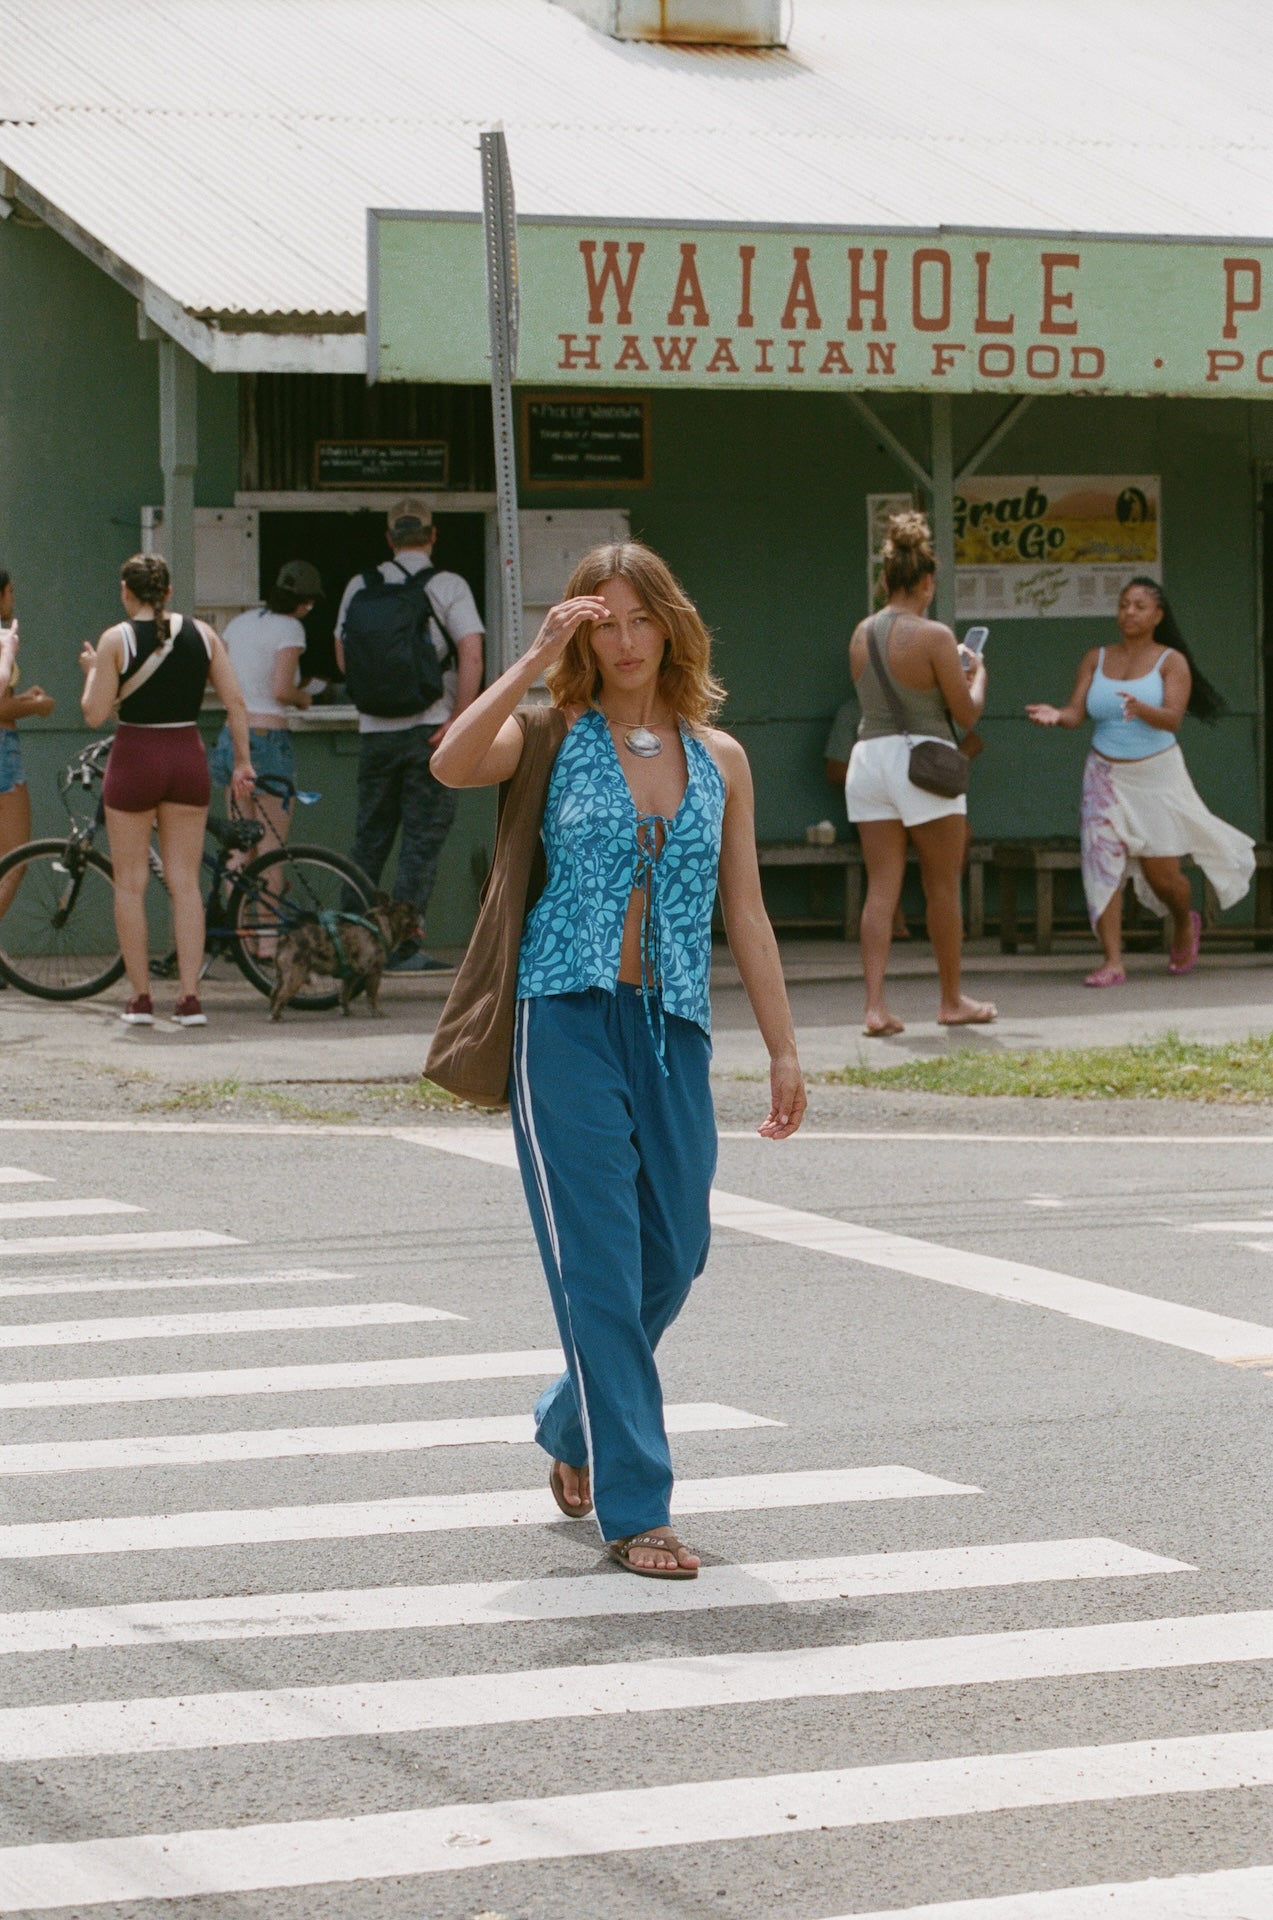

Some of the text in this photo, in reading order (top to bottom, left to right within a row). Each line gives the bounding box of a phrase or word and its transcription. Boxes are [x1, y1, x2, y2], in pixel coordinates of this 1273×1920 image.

[579, 240, 1080, 335] WAIAHOLE
[558, 334, 896, 374] HAWAIIAN
[931, 343, 1105, 379] FOOD
[1018, 520, 1065, 560] Go
